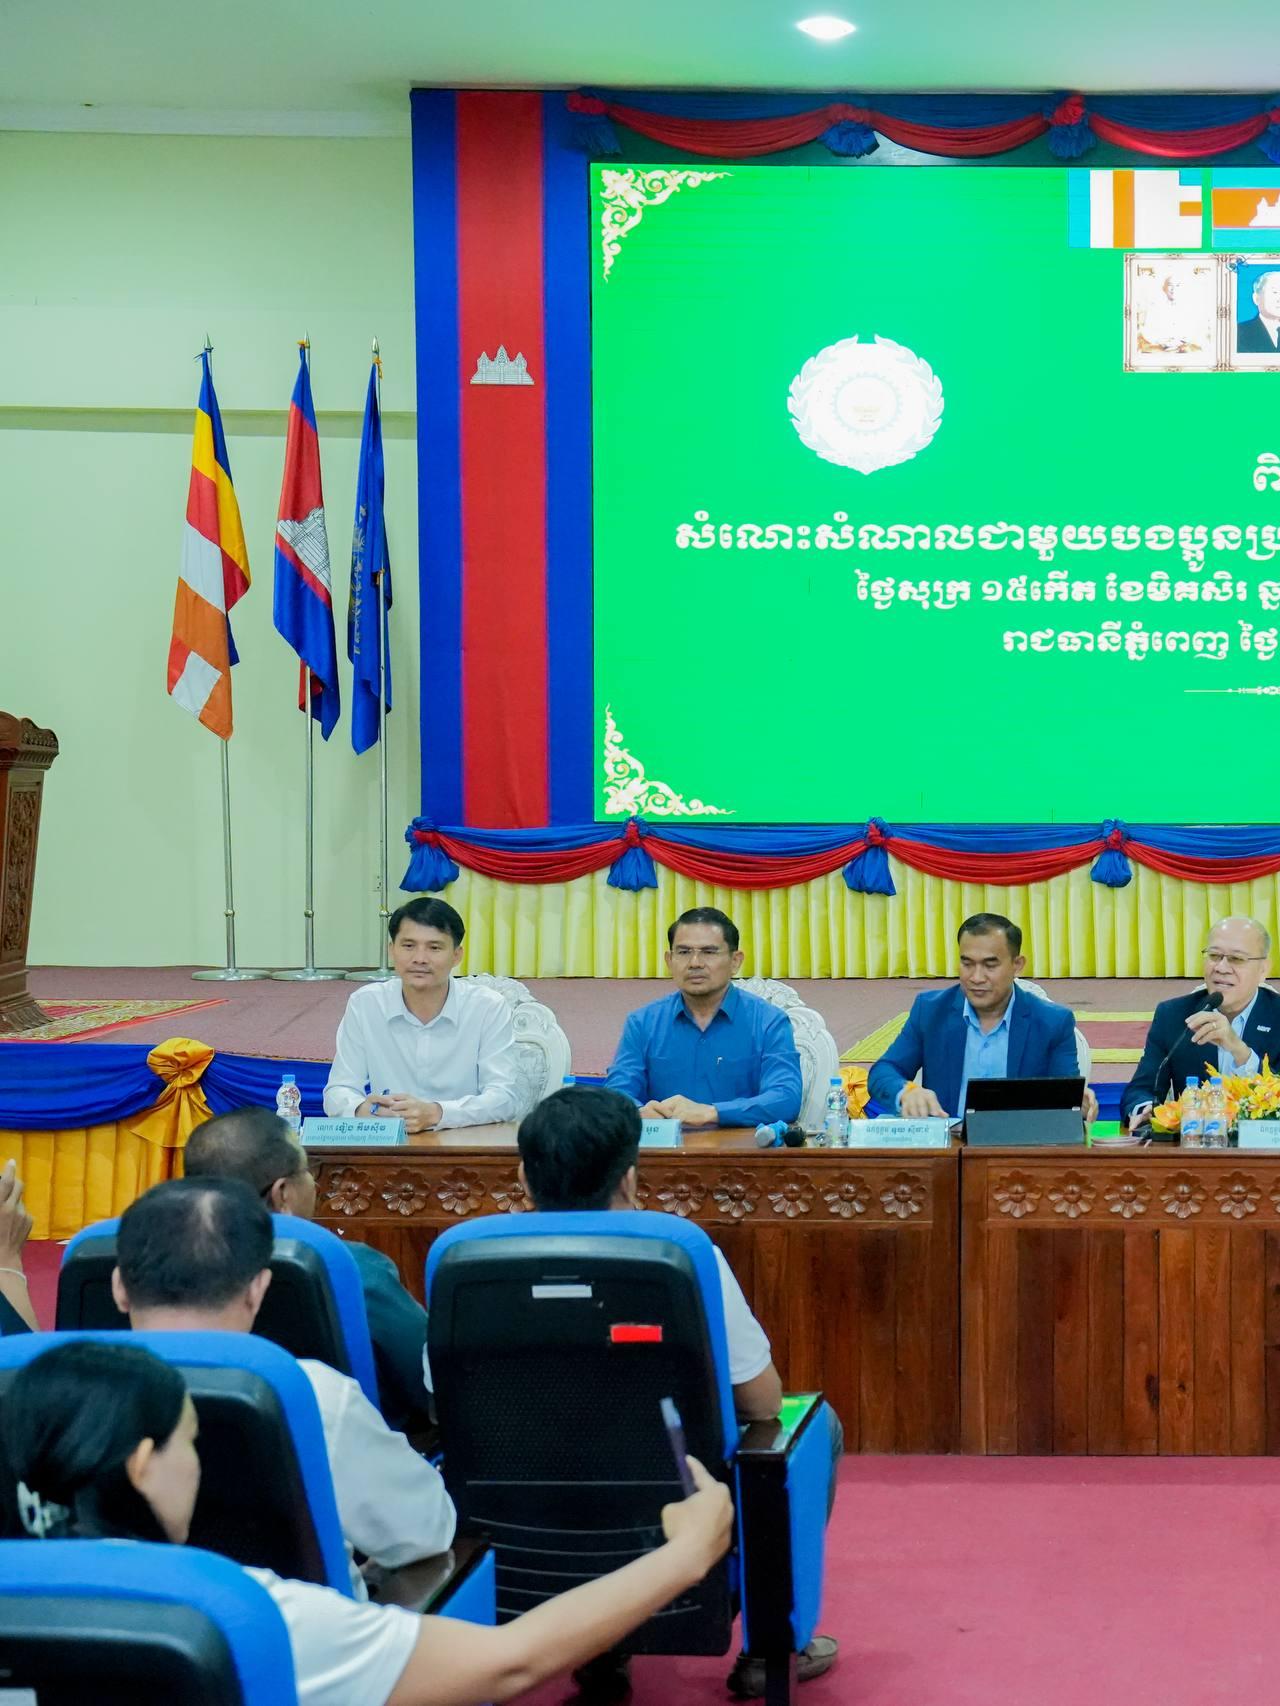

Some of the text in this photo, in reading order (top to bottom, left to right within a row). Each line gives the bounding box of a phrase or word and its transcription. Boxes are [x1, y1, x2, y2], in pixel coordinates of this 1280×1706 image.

[855, 569, 970, 609] ថ្ងៃសុក្រ
[982, 571, 1095, 601] ១៥កើត
[1106, 569, 1246, 601] ខែមិគសិរ
[1004, 622, 1228, 660] រាជធានីភ្នំពេញ
